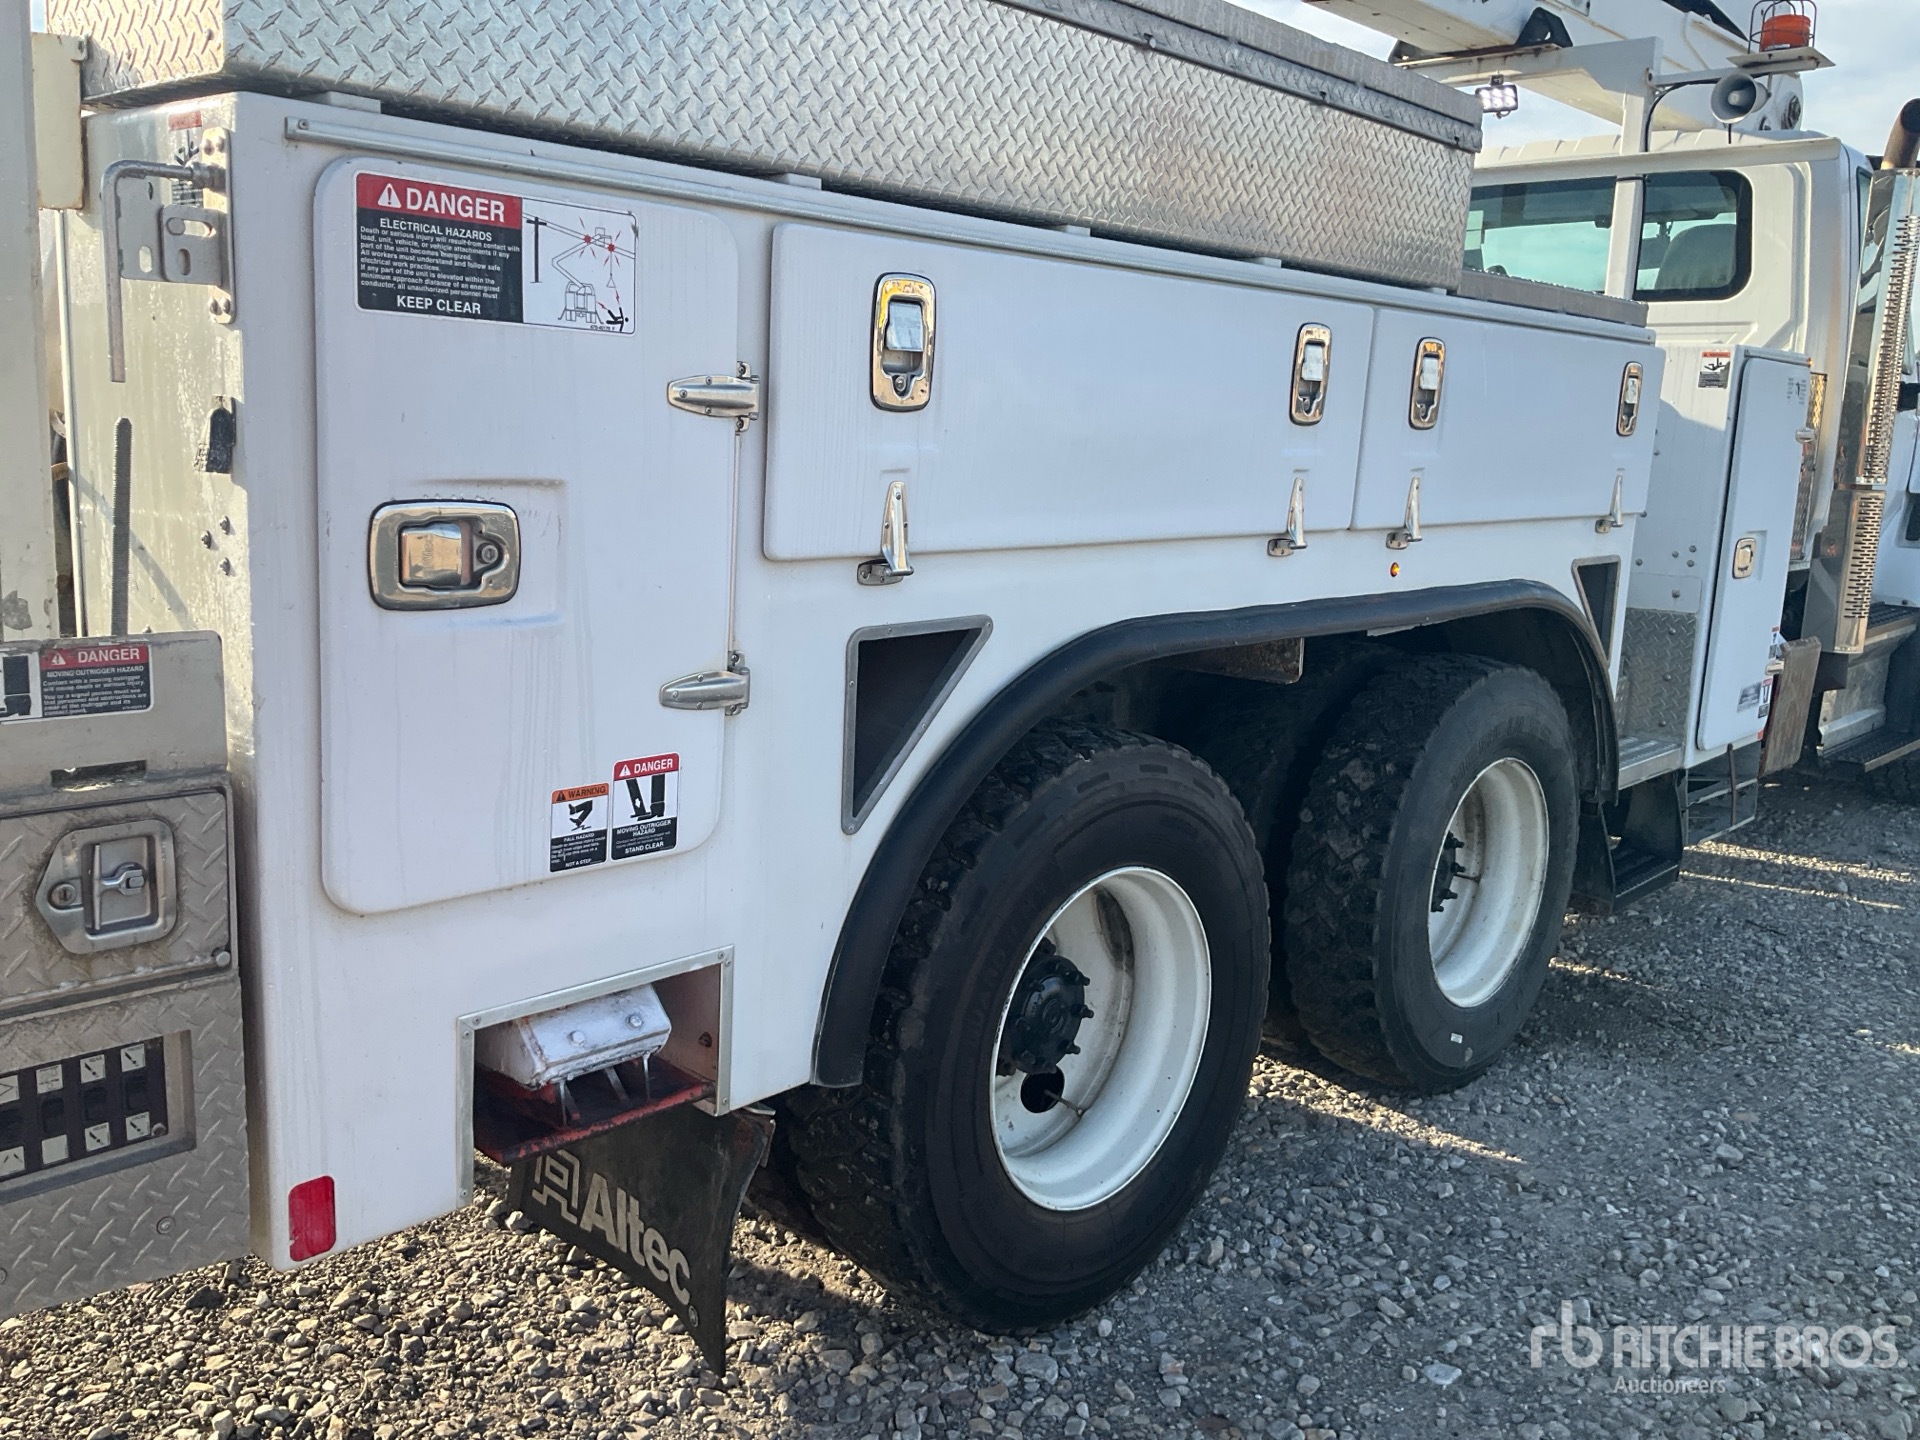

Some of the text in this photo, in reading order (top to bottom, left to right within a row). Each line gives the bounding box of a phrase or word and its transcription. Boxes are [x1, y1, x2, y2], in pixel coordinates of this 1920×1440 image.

[406, 187, 505, 223] DANGER
[380, 217, 491, 241] ELECTRICAL HAZARDS
[360, 225, 379, 234] Death
[389, 229, 414, 238] serious
[415, 233, 433, 242] injury
[483, 242, 506, 250] contact
[360, 241, 373, 249] part
[371, 250, 397, 258] workers
[396, 294, 480, 314] KEEP CLEAR
[78, 648, 140, 663] DANGER
[634, 758, 673, 774] DANGER
[568, 786, 606, 798] WARNING
[616, 819, 671, 834] MOVING OUTRIGGER
[632, 827, 655, 836] HAZARD
[625, 844, 644, 853] STAND
[645, 841, 663, 849] CLEAR
[579, 1172, 691, 1305] Altec
